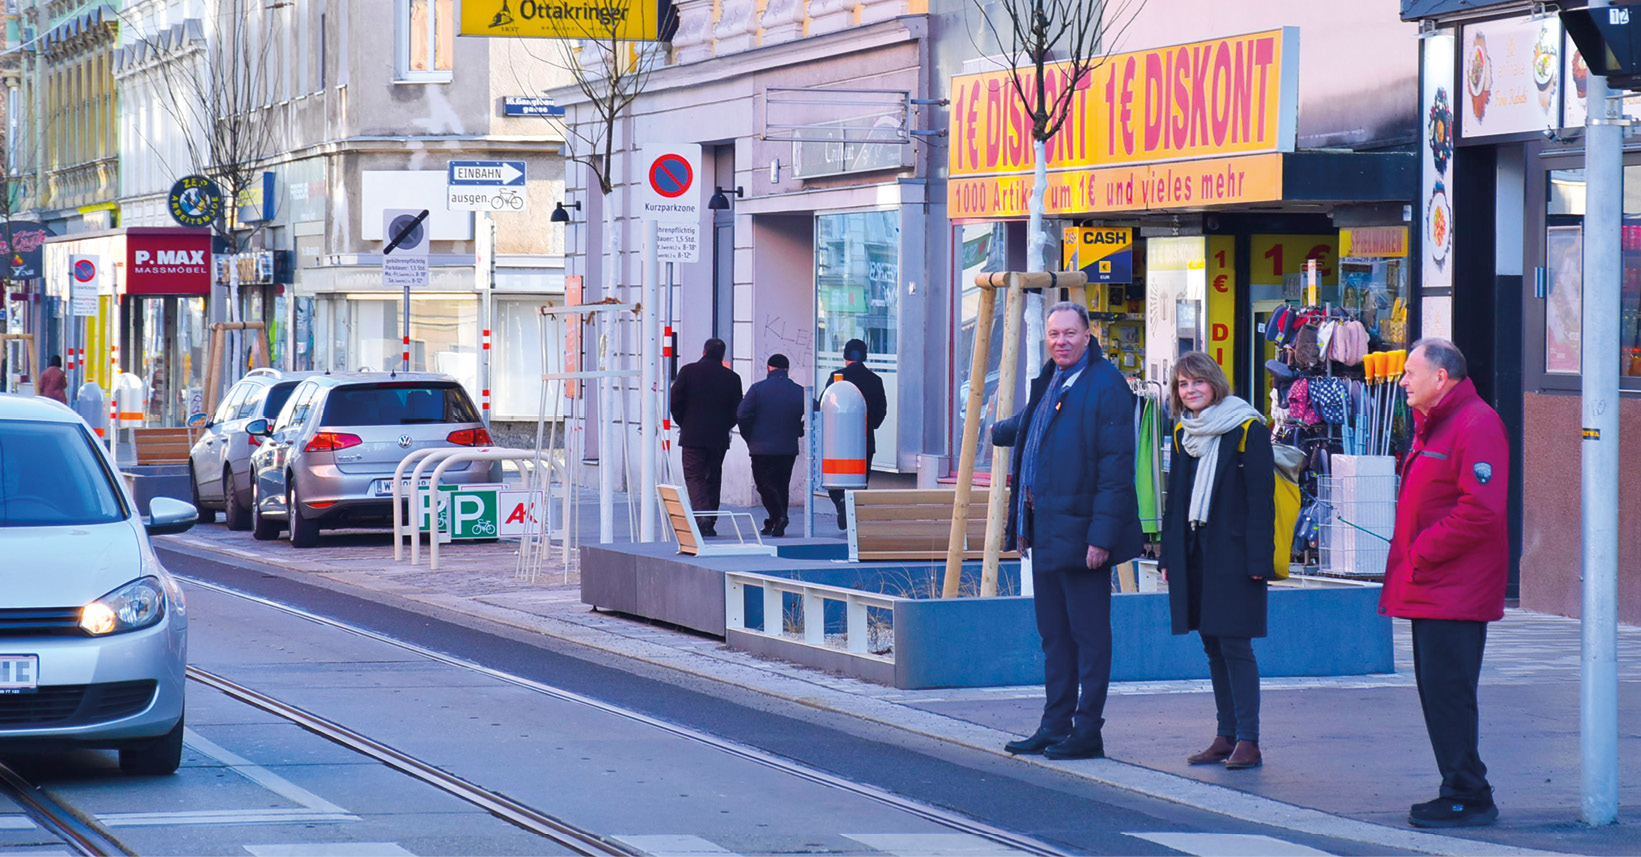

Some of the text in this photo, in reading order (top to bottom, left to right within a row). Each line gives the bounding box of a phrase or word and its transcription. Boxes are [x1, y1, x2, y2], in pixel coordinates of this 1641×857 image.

[520, 0, 629, 25] Ottakringer
[1105, 56, 1136, 156] 1€
[1144, 37, 1274, 152] DISKONT
[458, 168, 501, 178] EINBAHN
[956, 182, 986, 212] 1000
[993, 180, 1033, 211] Artik
[1051, 184, 1071, 209] um
[1106, 172, 1134, 206] und
[1142, 169, 1192, 205] vieles
[1201, 164, 1245, 200] mehr
[451, 194, 490, 205] ausgen.
[645, 203, 696, 212] Kurzparkzone
[658, 227, 695, 235] hrenpflichtig
[1083, 231, 1127, 244] CASH
[135, 250, 205, 265] P.MAX
[135, 266, 207, 274] MASSMÖBEL
[454, 495, 485, 535] P
[505, 502, 538, 524] AK
